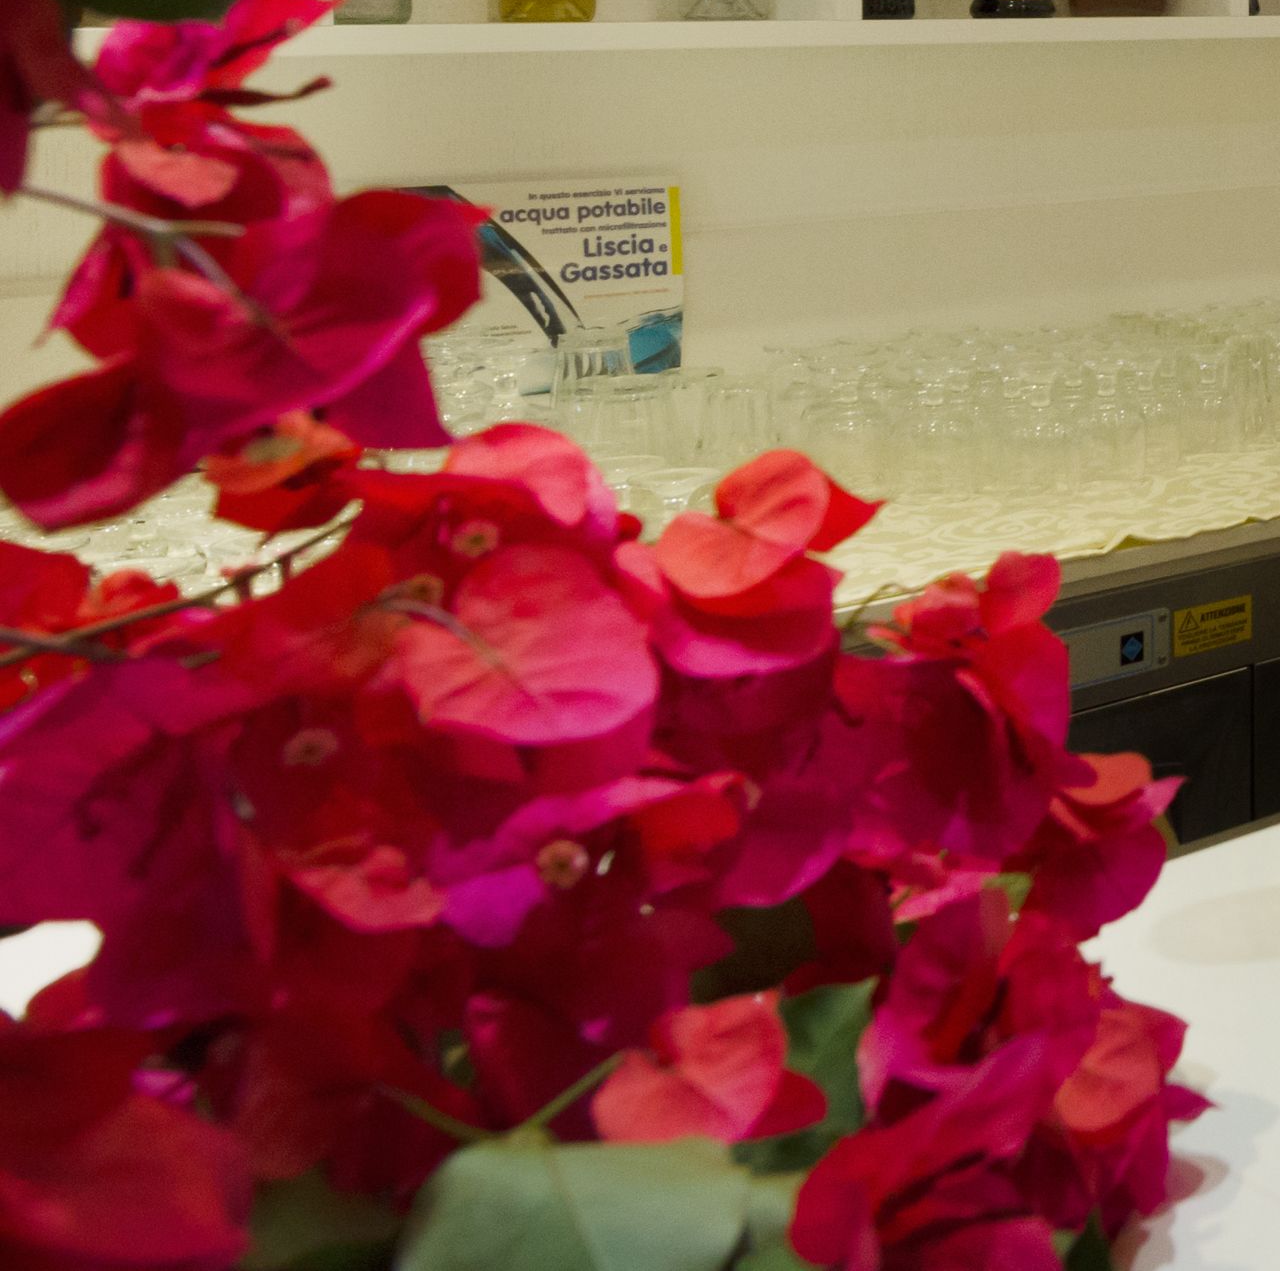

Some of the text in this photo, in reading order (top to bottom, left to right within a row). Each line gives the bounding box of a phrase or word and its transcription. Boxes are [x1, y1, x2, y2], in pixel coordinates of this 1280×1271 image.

[539, 191, 571, 201] questo
[625, 187, 665, 196] serviamo
[500, 198, 666, 226] acqua potabile
[579, 225, 596, 233] con
[598, 221, 667, 232] microfiltrazione
[583, 233, 668, 258] Liscia e
[560, 258, 668, 284] Gassata
[1200, 602, 1246, 623] ATTENZIONE
